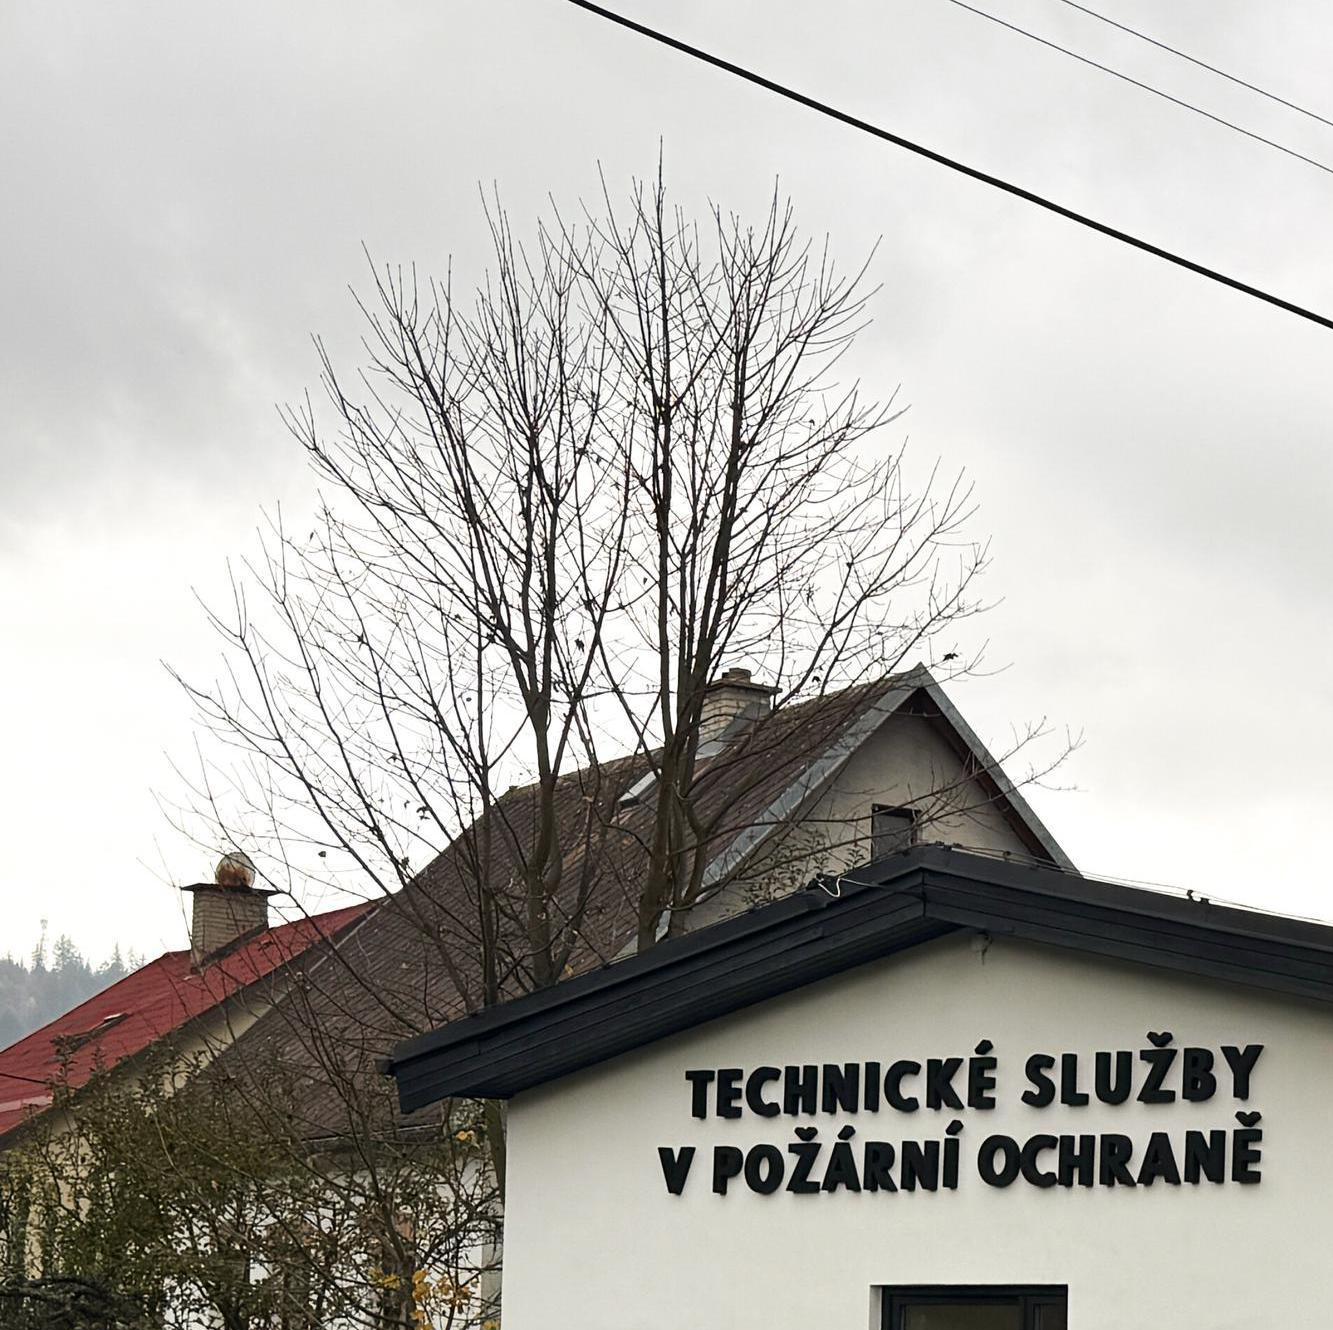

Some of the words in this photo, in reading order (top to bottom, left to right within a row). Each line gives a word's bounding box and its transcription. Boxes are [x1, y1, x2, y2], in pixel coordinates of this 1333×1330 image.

[685, 1040, 997, 1120] TECHNICKÉ
[1021, 1032, 1264, 1109] SLUŽBY
[658, 1146, 696, 1196] V
[712, 1127, 963, 1196] POŽÁRNÍ
[978, 1112, 1262, 1189] OCHRANĚ
